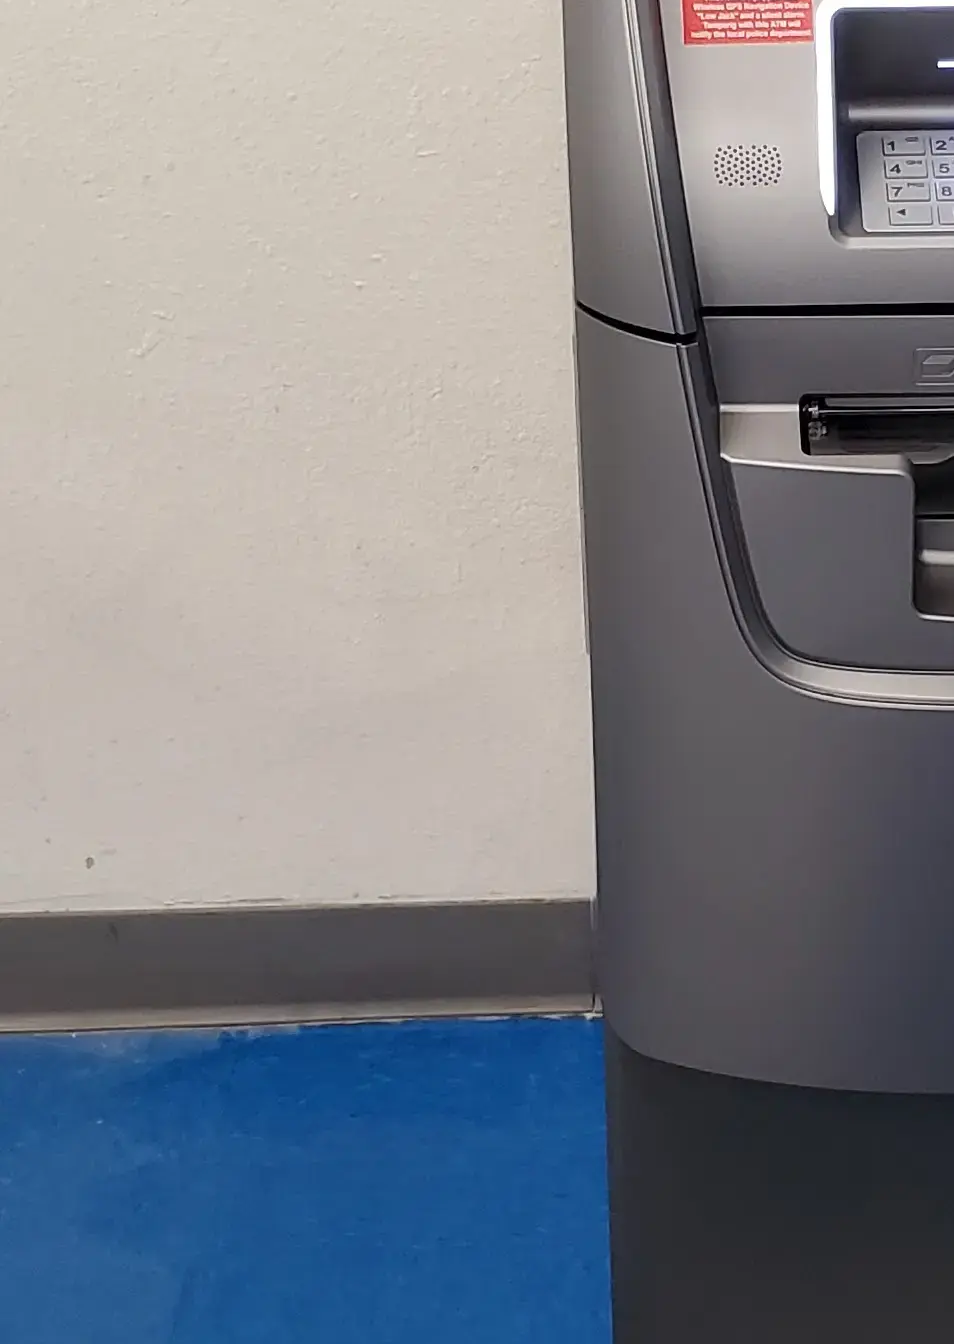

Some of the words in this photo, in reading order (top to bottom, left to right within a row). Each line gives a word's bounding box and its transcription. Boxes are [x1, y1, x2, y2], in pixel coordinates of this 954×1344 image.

[726, 2, 743, 10] GPS
[744, 2, 783, 11] Navigation
[784, 1, 810, 9] Device
[770, 20, 787, 28] ATM
[886, 140, 896, 152] 1
[935, 140, 947, 151] 2
[889, 163, 901, 174] 4
[938, 162, 950, 174] 5
[891, 186, 903, 198] 7
[941, 186, 952, 197] 8
